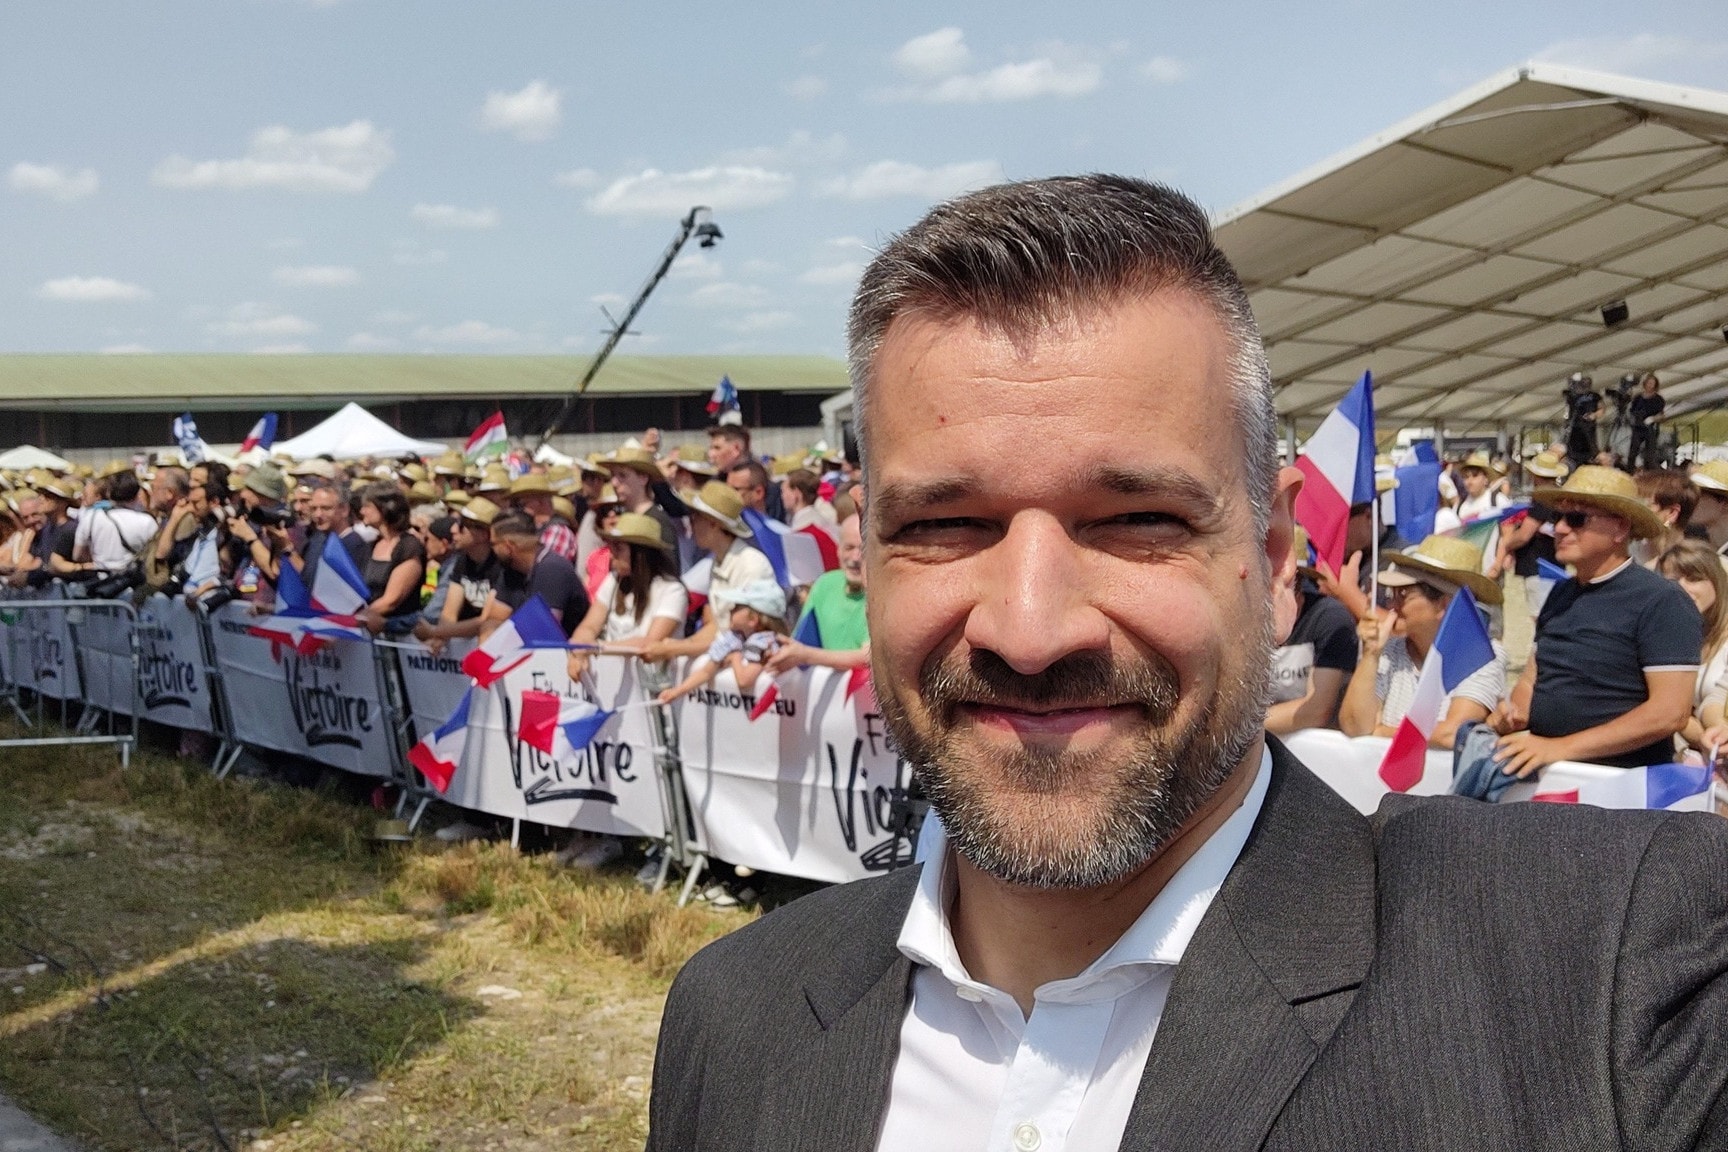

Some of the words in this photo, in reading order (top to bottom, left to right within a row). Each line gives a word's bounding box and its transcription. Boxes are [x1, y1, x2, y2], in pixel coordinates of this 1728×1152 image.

[284, 656, 372, 734] Victoire
[407, 655, 464, 674] PATRIOTE
[687, 689, 796, 717] PATRIOT.EU
[505, 696, 638, 788] Vicoire
[826, 737, 897, 852] Vic
